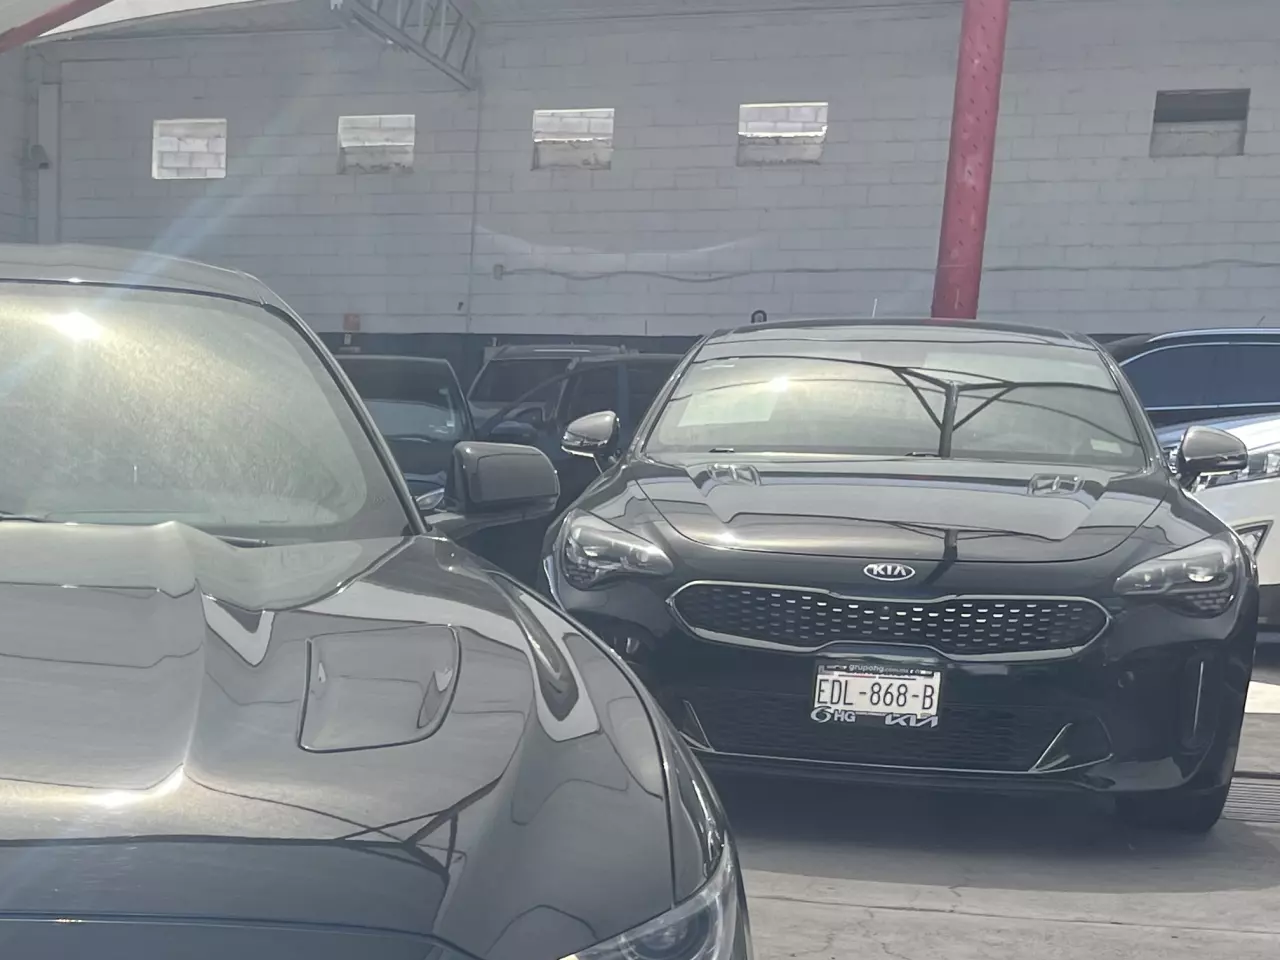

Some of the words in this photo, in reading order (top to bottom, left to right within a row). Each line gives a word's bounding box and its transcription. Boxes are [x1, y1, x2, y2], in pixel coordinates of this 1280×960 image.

[871, 563, 907, 576] KIA
[817, 679, 935, 710] EDL-868-B
[834, 710, 856, 723] HG
